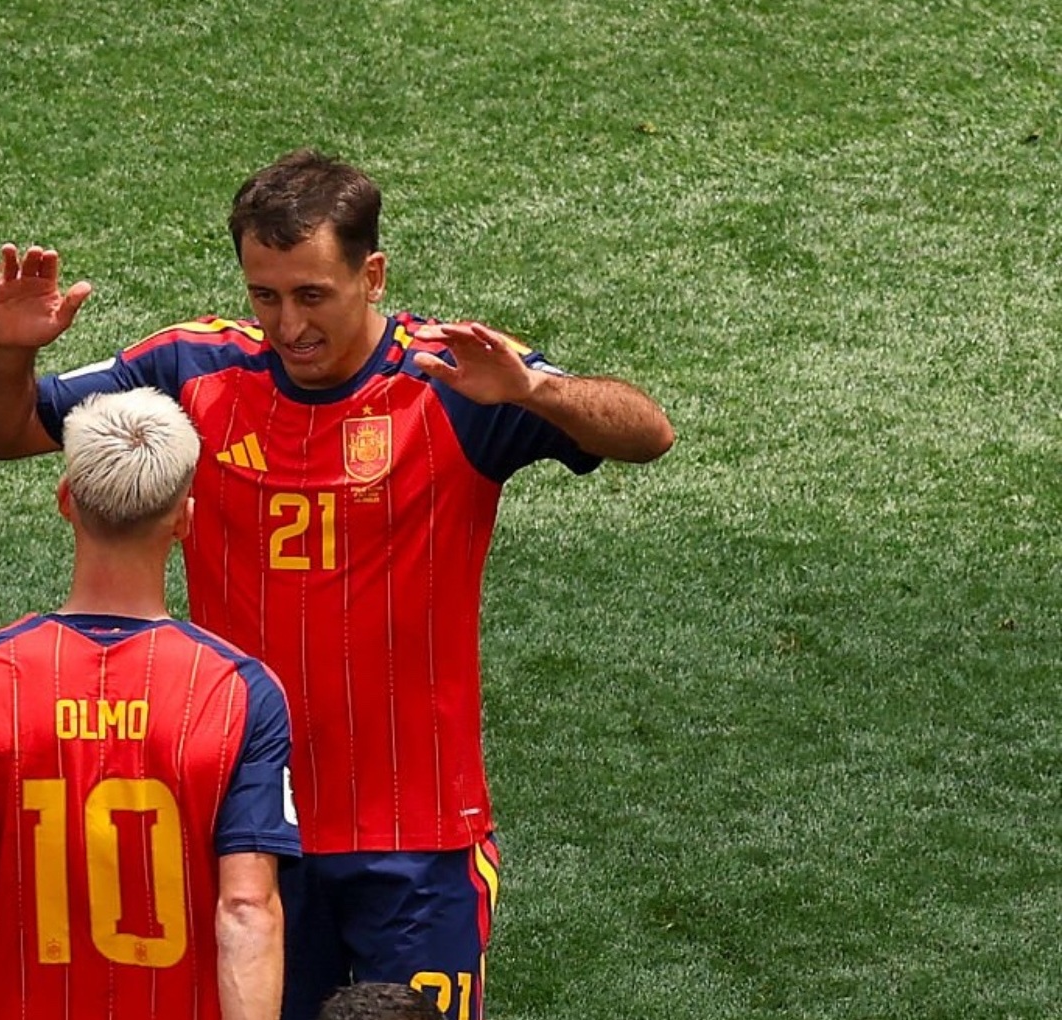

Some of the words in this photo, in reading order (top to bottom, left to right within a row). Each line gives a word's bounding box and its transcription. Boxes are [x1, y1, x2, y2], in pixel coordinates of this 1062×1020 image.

[269, 492, 336, 570] 21
[55, 699, 149, 740] OLMO
[22, 778, 187, 968] 10
